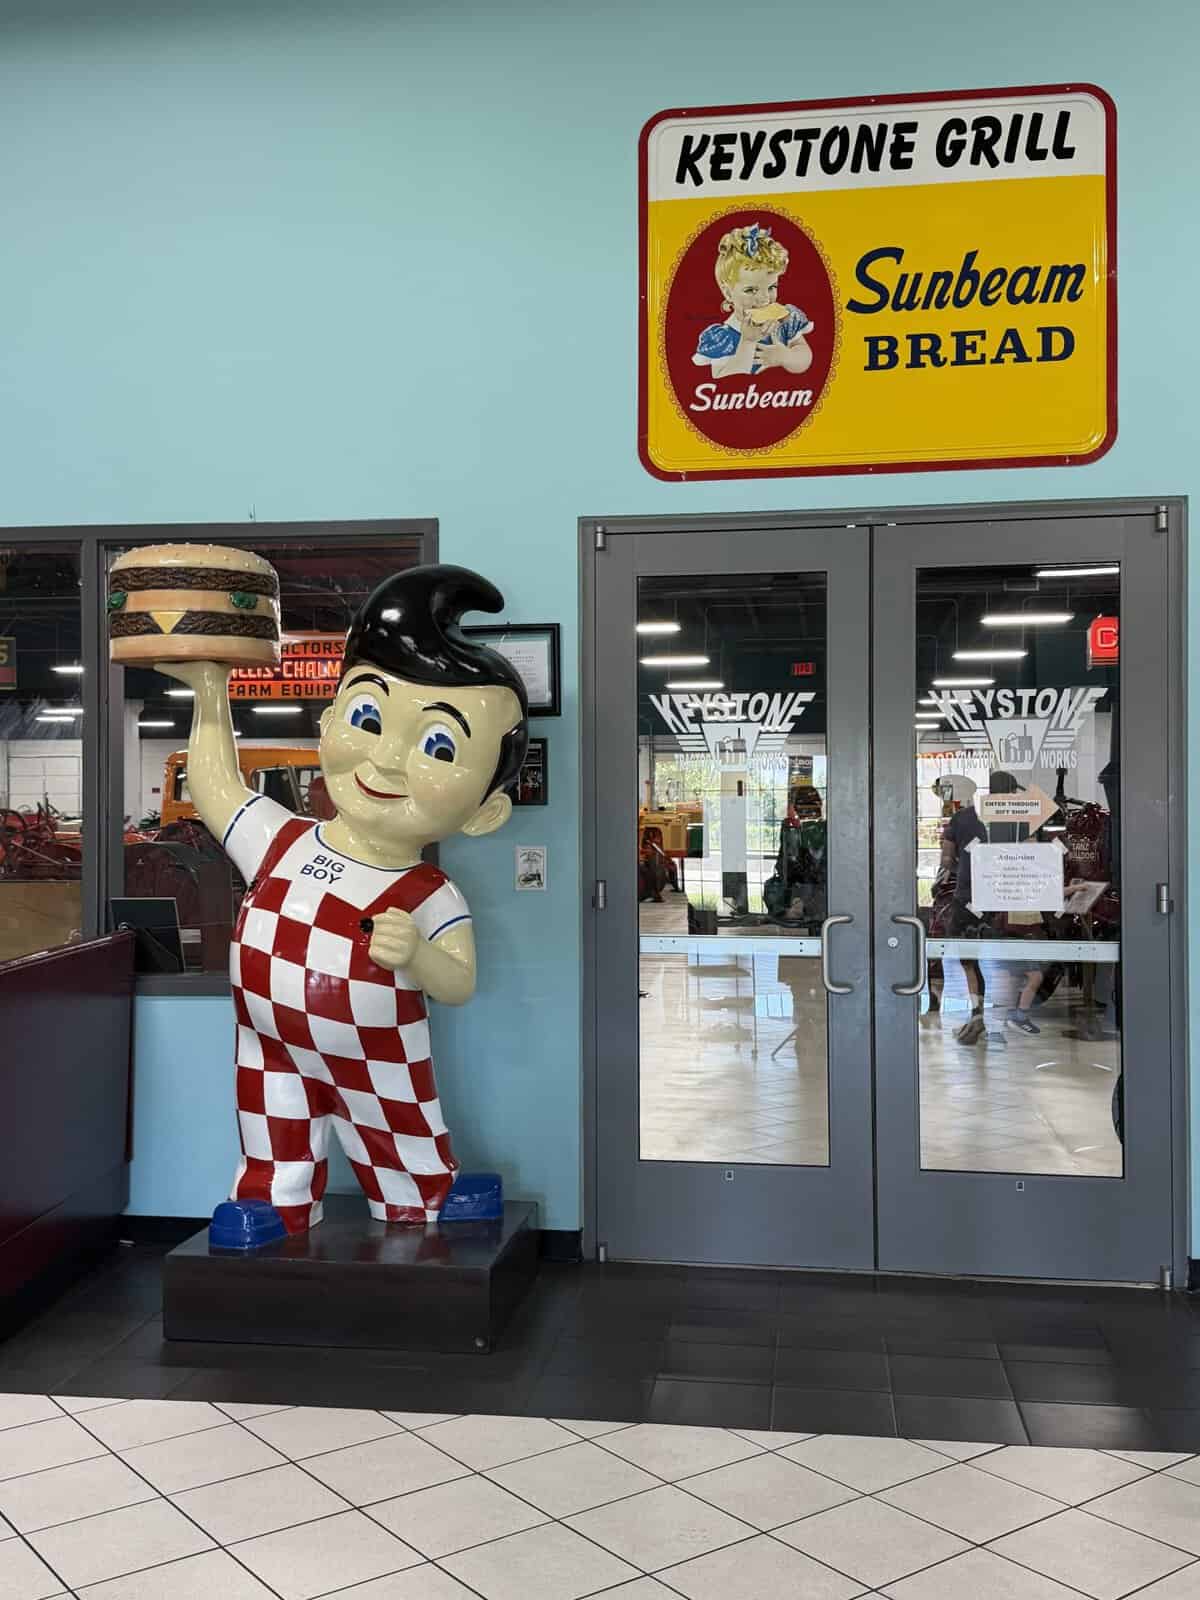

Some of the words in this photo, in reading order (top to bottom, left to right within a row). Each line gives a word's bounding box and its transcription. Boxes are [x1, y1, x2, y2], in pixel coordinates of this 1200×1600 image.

[675, 121, 918, 187] KEYSTONE
[935, 110, 1076, 168] GRILL
[846, 246, 1086, 315] Sunbeam
[863, 326, 1075, 372] BREAD
[689, 383, 813, 412] Sunbeam
[281, 642, 344, 655] ACTORS
[281, 684, 338, 696] EQUIP
[648, 692, 816, 734] KEYSTONE
[928, 687, 1109, 731] KEYSTONE
[1039, 749, 1078, 768] WORKS
[300, 863, 342, 884] BOY
[312, 854, 345, 873] BIG
